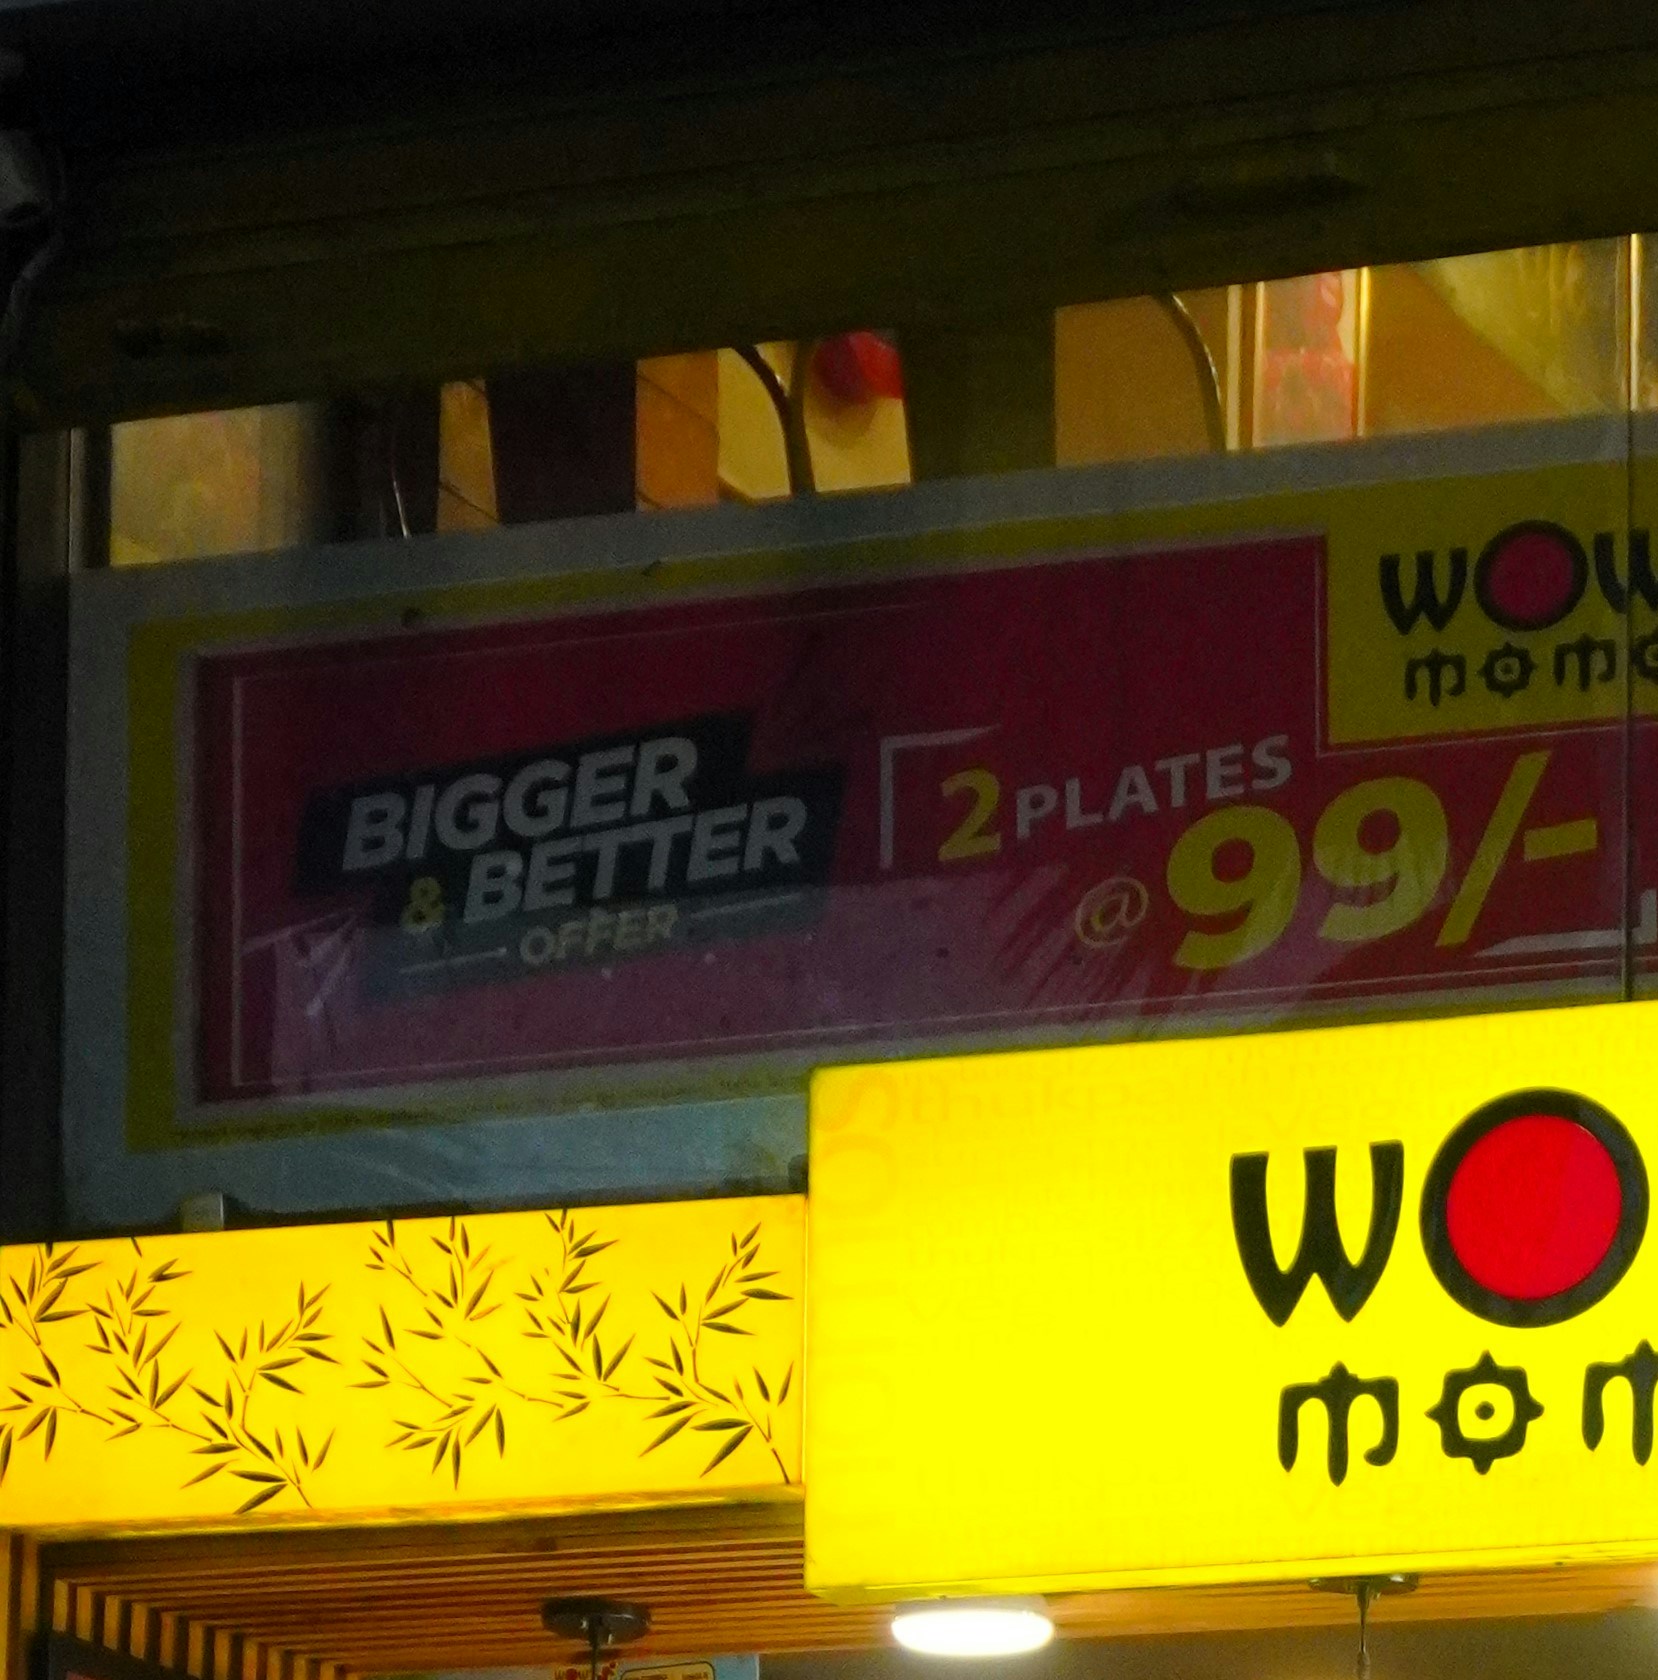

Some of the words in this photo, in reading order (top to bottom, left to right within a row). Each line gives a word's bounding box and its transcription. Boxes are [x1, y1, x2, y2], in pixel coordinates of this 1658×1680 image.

[342, 736, 698, 873] BIGGER
[401, 875, 447, 934] &
[462, 796, 808, 923] BETTER
[938, 762, 1003, 862] 2
[1015, 734, 1293, 840] PLATES
[1166, 750, 1597, 974] 99/-
[519, 903, 679, 966] OFFER
